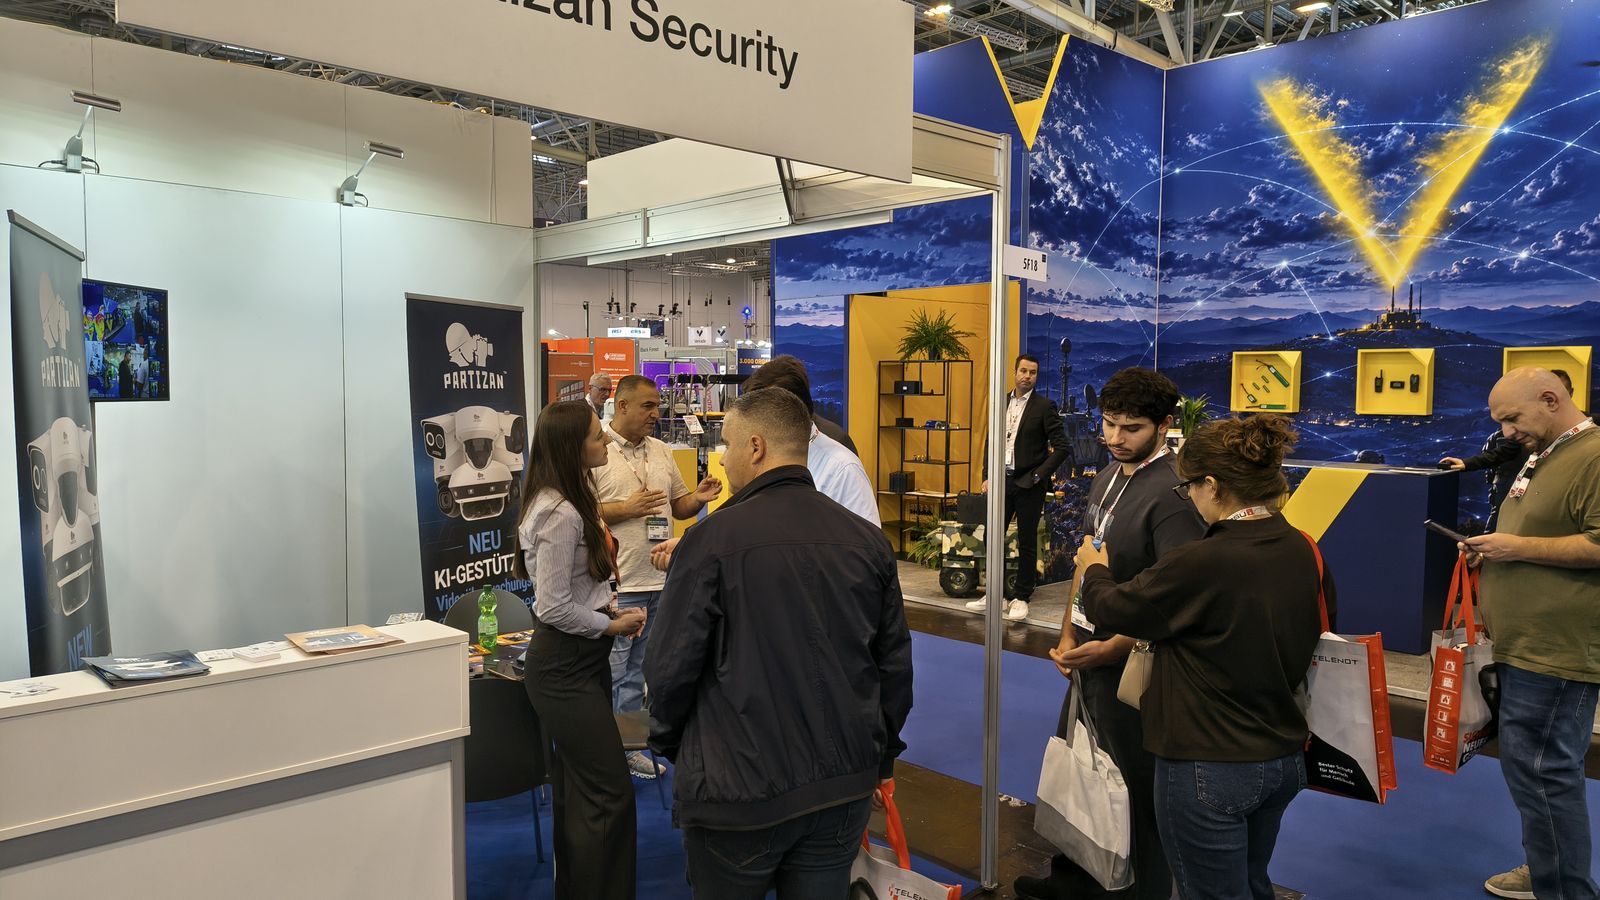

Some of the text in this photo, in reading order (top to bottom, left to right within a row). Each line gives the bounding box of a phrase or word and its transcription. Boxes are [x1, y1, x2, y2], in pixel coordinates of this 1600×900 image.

[629, 0, 799, 89] Security
[41, 355, 80, 388] PARTIZAN
[443, 370, 504, 390] PARTIZAN
[468, 529, 501, 555] NEU
[68, 623, 92, 672] NEW
[1312, 654, 1359, 665] TELENOT
